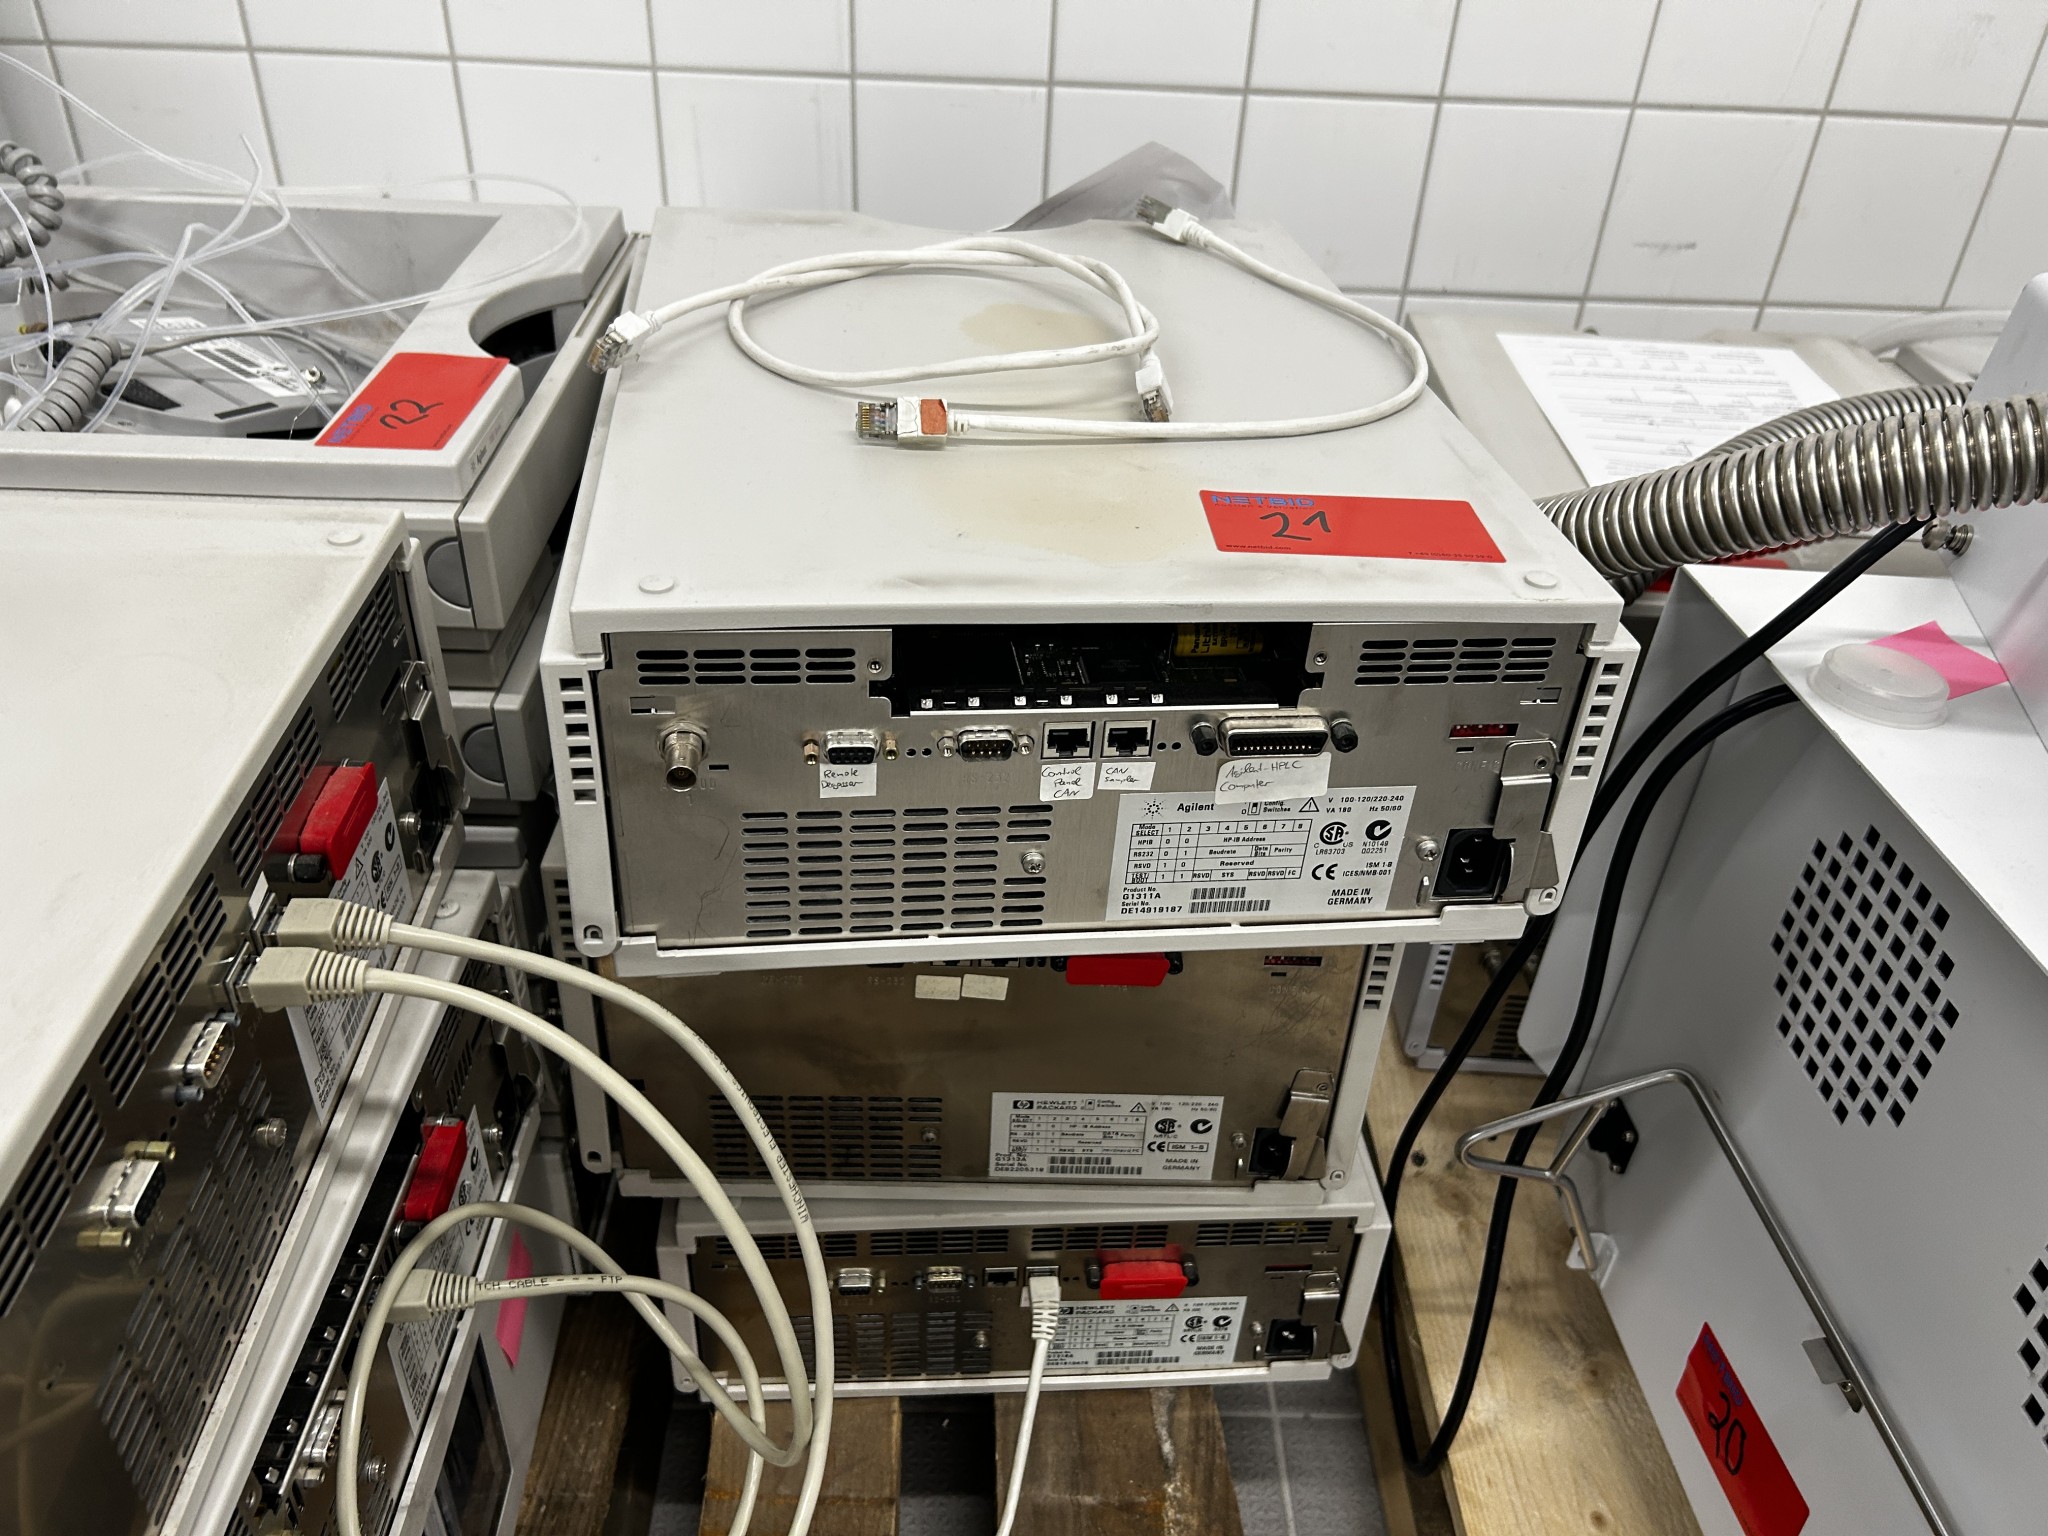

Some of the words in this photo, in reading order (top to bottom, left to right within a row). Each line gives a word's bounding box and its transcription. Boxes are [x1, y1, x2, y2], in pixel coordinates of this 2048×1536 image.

[380, 399, 444, 430] 22
[1211, 495, 1315, 507] NETBID
[1259, 510, 1332, 541] 21
[823, 768, 859, 779] Remote
[1041, 766, 1082, 777] Control
[1105, 767, 1129, 775] CAN
[1053, 777, 1082, 788] Panel
[1219, 779, 1275, 792] Computer
[1053, 788, 1080, 799] CAN
[1176, 802, 1215, 812] Agilent
[1273, 846, 1293, 854] Parity
[1331, 888, 1359, 897] MADE
[1360, 888, 1371, 896] IN
[1327, 896, 1374, 906] GERMANY
[508, 1278, 551, 1289] CABLE
[601, 1275, 623, 1284] FTP
